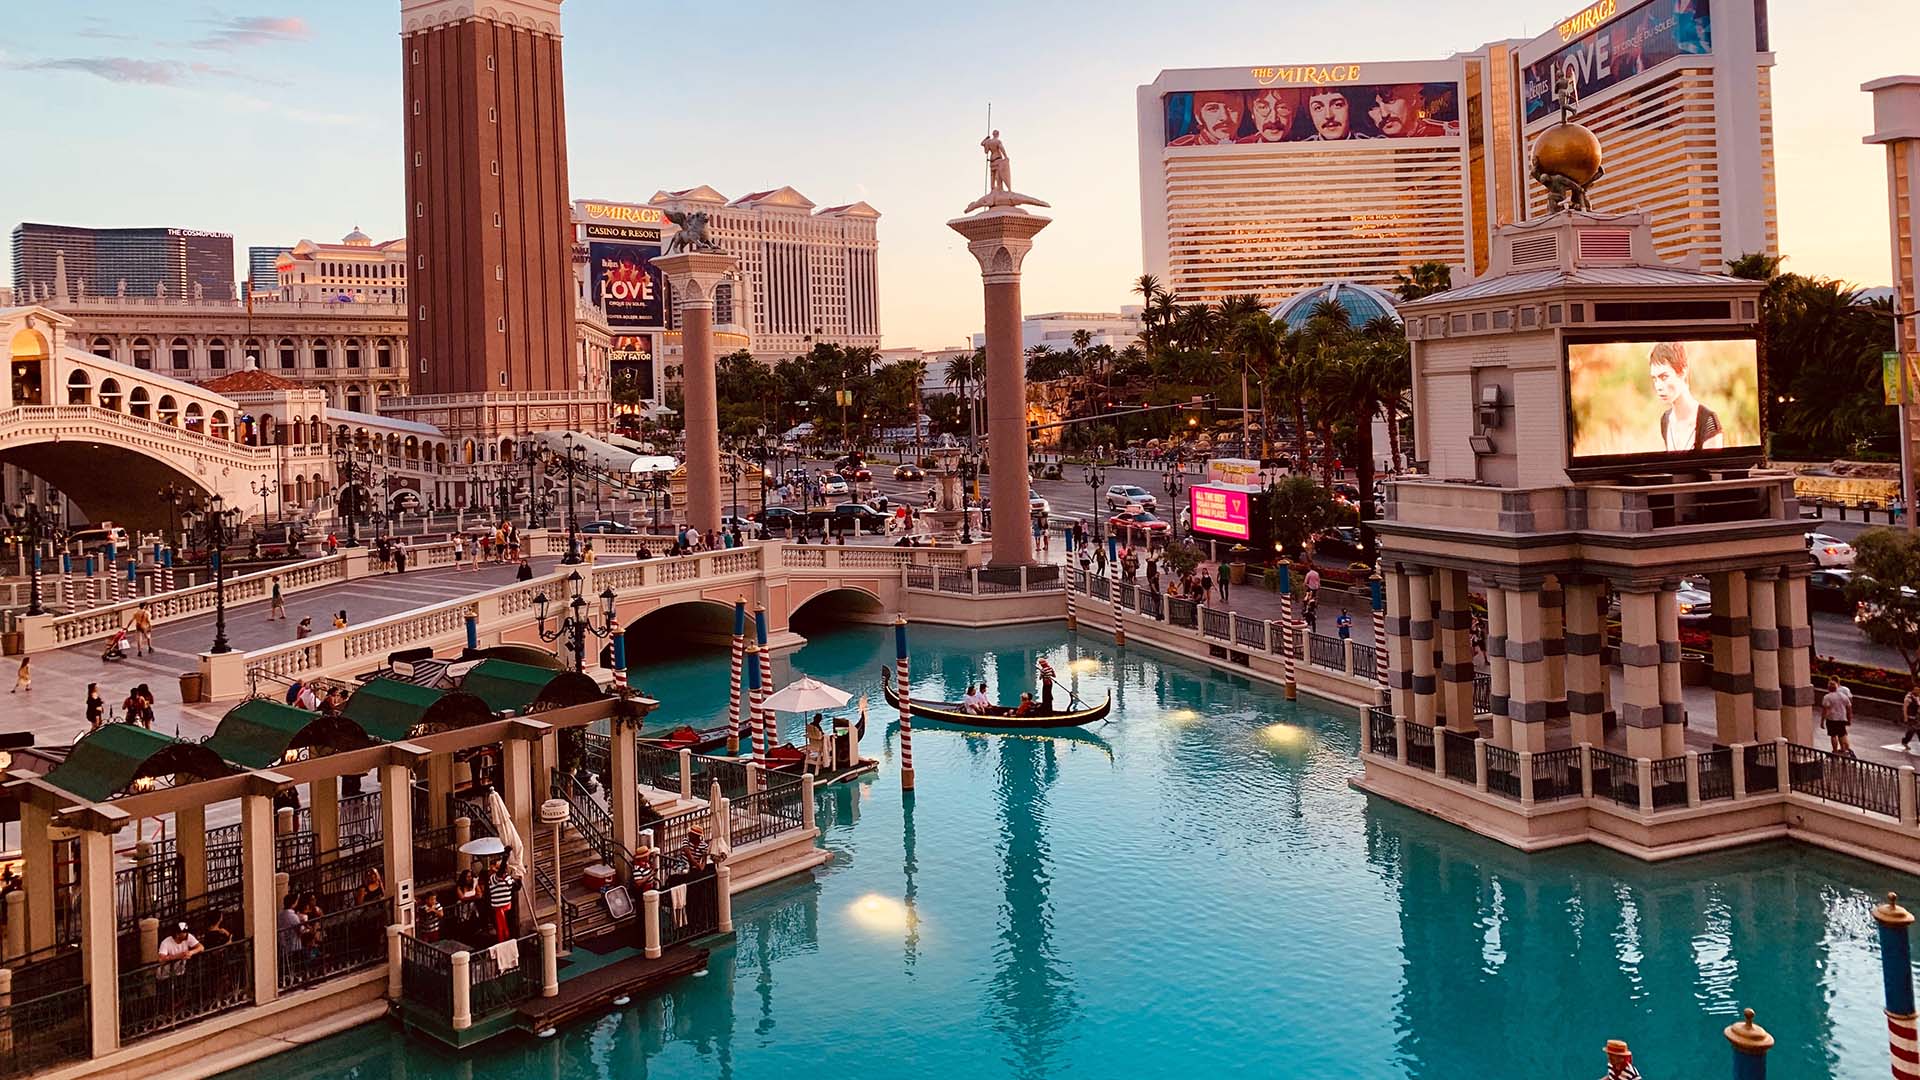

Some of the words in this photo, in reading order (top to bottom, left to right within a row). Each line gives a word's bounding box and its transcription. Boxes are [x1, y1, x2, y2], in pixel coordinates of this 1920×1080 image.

[1563, 0, 1617, 42] MIRAGE
[1251, 67, 1274, 78] THE
[1259, 65, 1360, 85] MIRAGE
[1550, 33, 1611, 102] LOVE
[585, 204, 603, 214] THE
[590, 206, 661, 223] MIRAGE
[182, 230, 233, 238] COSMOPOLITAN
[588, 226, 619, 236] CASINO
[628, 230, 660, 239] RESORT
[601, 280, 654, 300] LOVE
[610, 353, 628, 361] ERRY
[629, 353, 651, 361] FATOR
